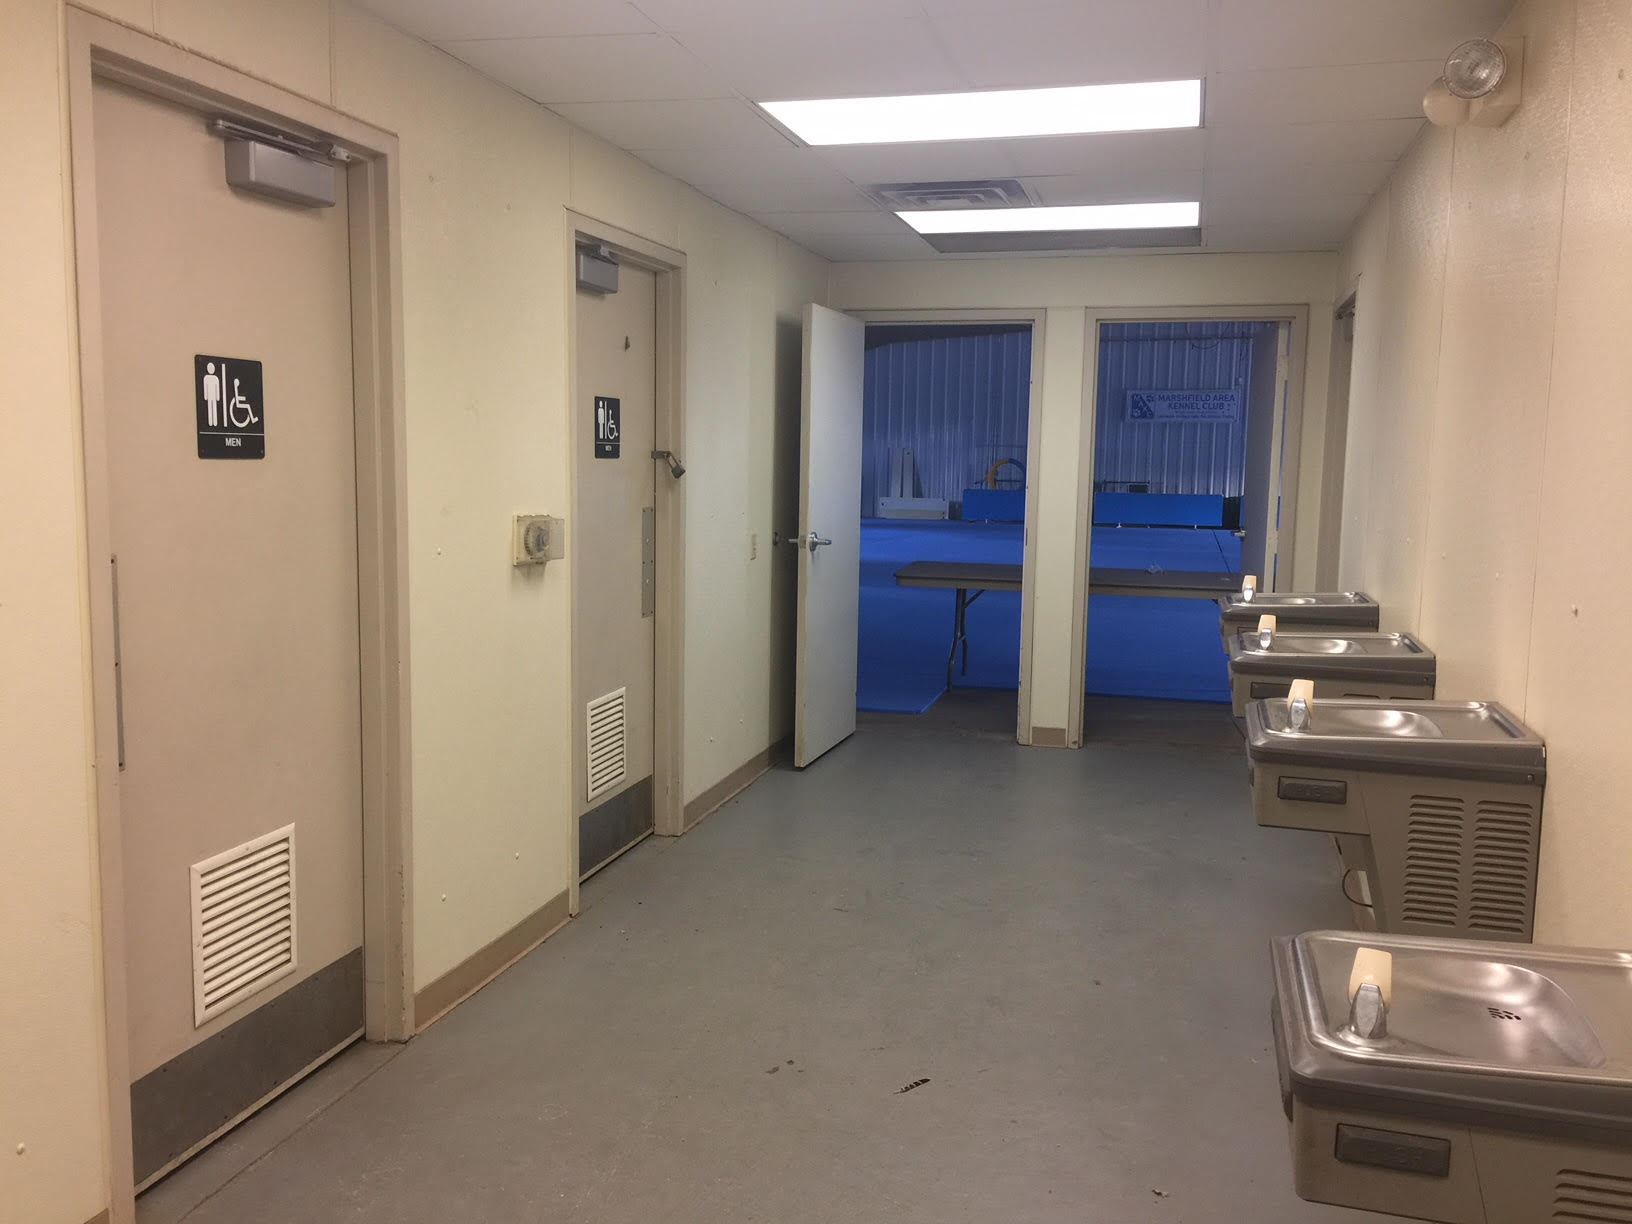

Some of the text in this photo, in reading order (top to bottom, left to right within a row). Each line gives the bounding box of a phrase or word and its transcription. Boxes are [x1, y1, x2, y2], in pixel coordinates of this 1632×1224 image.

[1158, 394, 1235, 402] MARSHFIELD AREA
[1168, 402, 1225, 410] KENNEL CLUB
[225, 437, 242, 447] MEN
